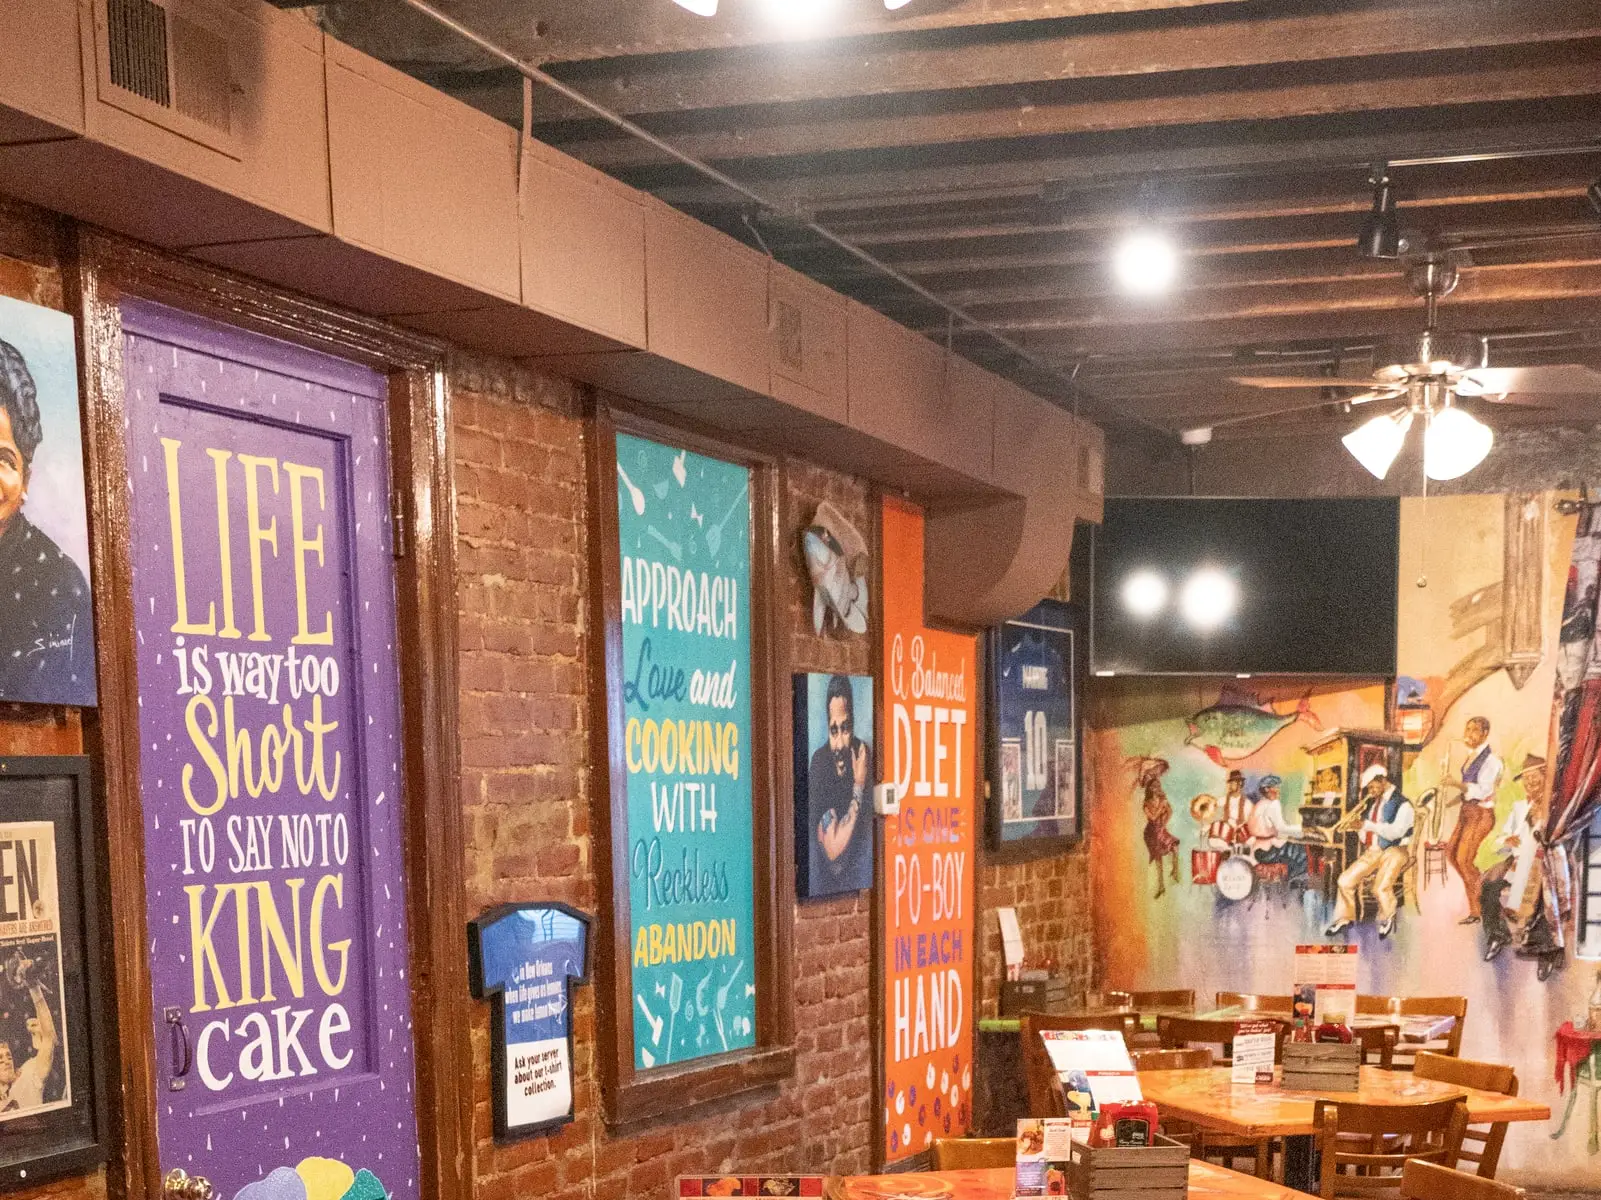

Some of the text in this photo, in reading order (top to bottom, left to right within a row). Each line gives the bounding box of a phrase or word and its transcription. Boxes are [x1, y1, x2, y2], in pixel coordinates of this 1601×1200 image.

[160, 437, 334, 646] LIFE
[622, 556, 737, 641] APPROACH
[175, 636, 340, 706] is way too
[623, 636, 738, 713] Love and
[911, 635, 967, 702] Balanced
[181, 693, 341, 816] Short
[625, 720, 738, 781] COOKING
[893, 703, 967, 799] DIET
[1024, 710, 1047, 791] 10
[180, 813, 349, 875] TO SAY NO TO
[651, 782, 717, 834] WITH
[898, 806, 960, 846] IS ONE
[632, 836, 730, 911] Reckless
[894, 851, 966, 928] PO-BOY
[183, 874, 352, 1013] KING
[634, 918, 736, 968] ABANDON
[894, 928, 963, 973] IN EACH
[197, 1003, 354, 1091] cake
[894, 969, 962, 1063] HAND
[514, 1060, 562, 1084] about our t-shirt
[515, 1048, 559, 1069] Ask your server
[524, 1079, 556, 1097] collection.
